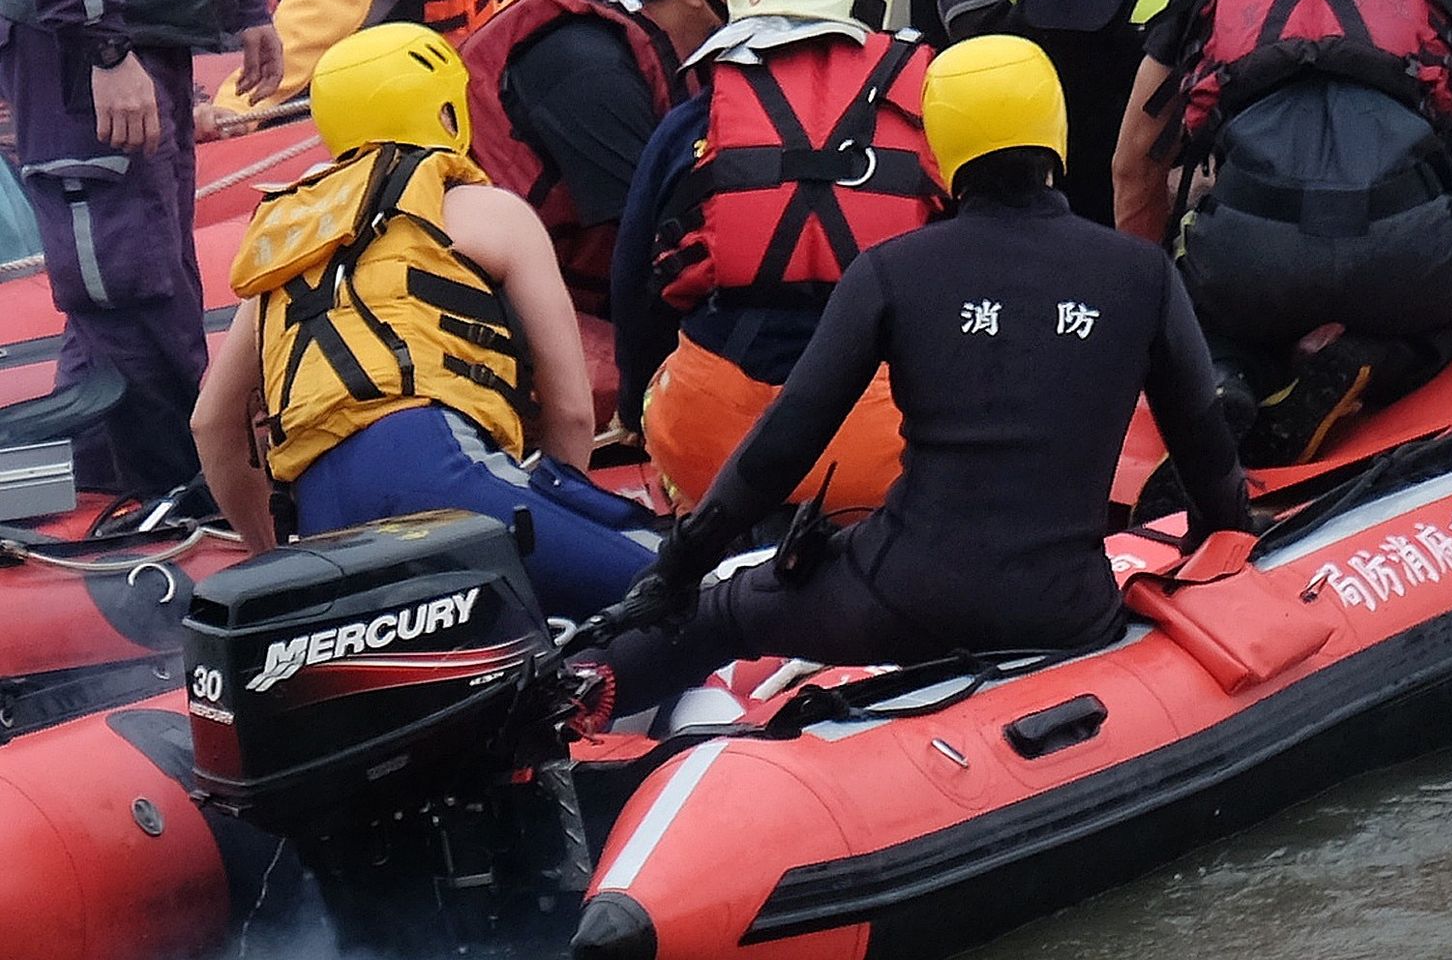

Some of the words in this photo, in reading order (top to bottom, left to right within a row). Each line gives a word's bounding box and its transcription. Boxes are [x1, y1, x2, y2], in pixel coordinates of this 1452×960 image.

[960, 298, 1100, 340] 消防
[246, 588, 480, 692] MERCURY
[192, 665, 222, 702] 30
